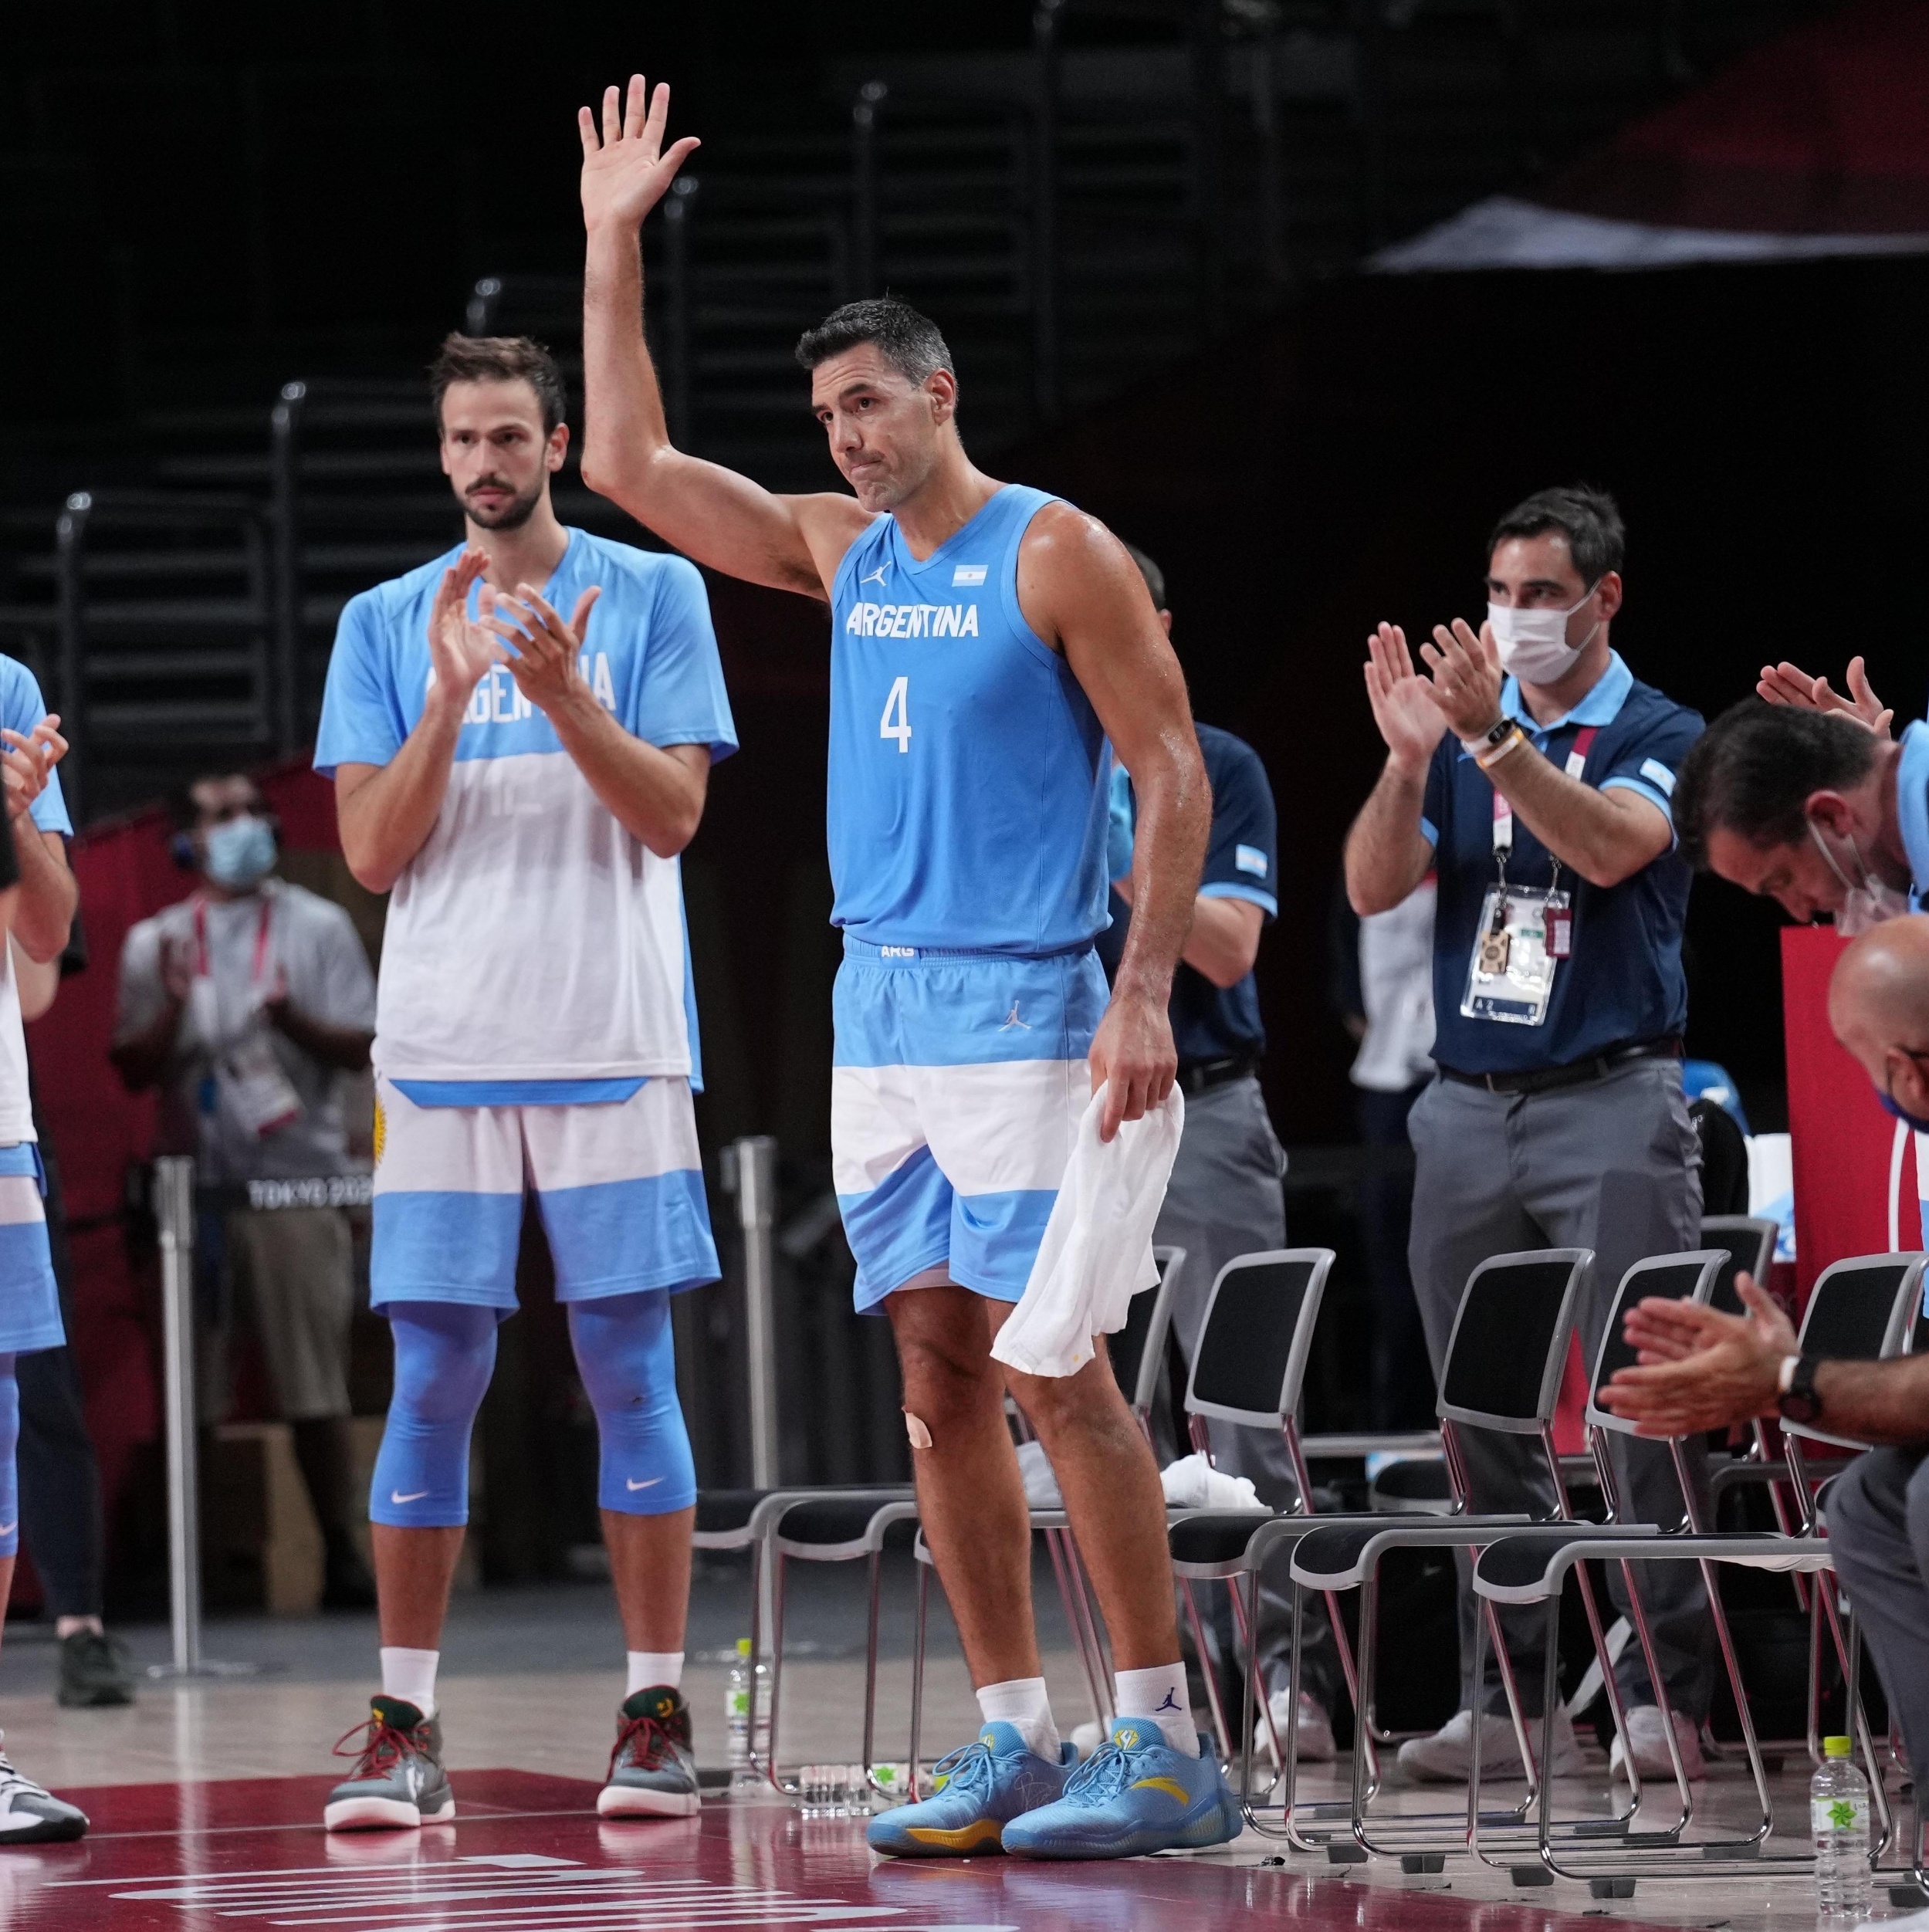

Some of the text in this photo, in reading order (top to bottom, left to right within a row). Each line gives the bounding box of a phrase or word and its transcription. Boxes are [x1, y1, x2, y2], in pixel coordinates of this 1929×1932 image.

[847, 602, 979, 638] ARGENTINA
[880, 676, 912, 753] 4
[881, 946, 915, 957] ARG
[248, 1177, 328, 1210] TOKYO
